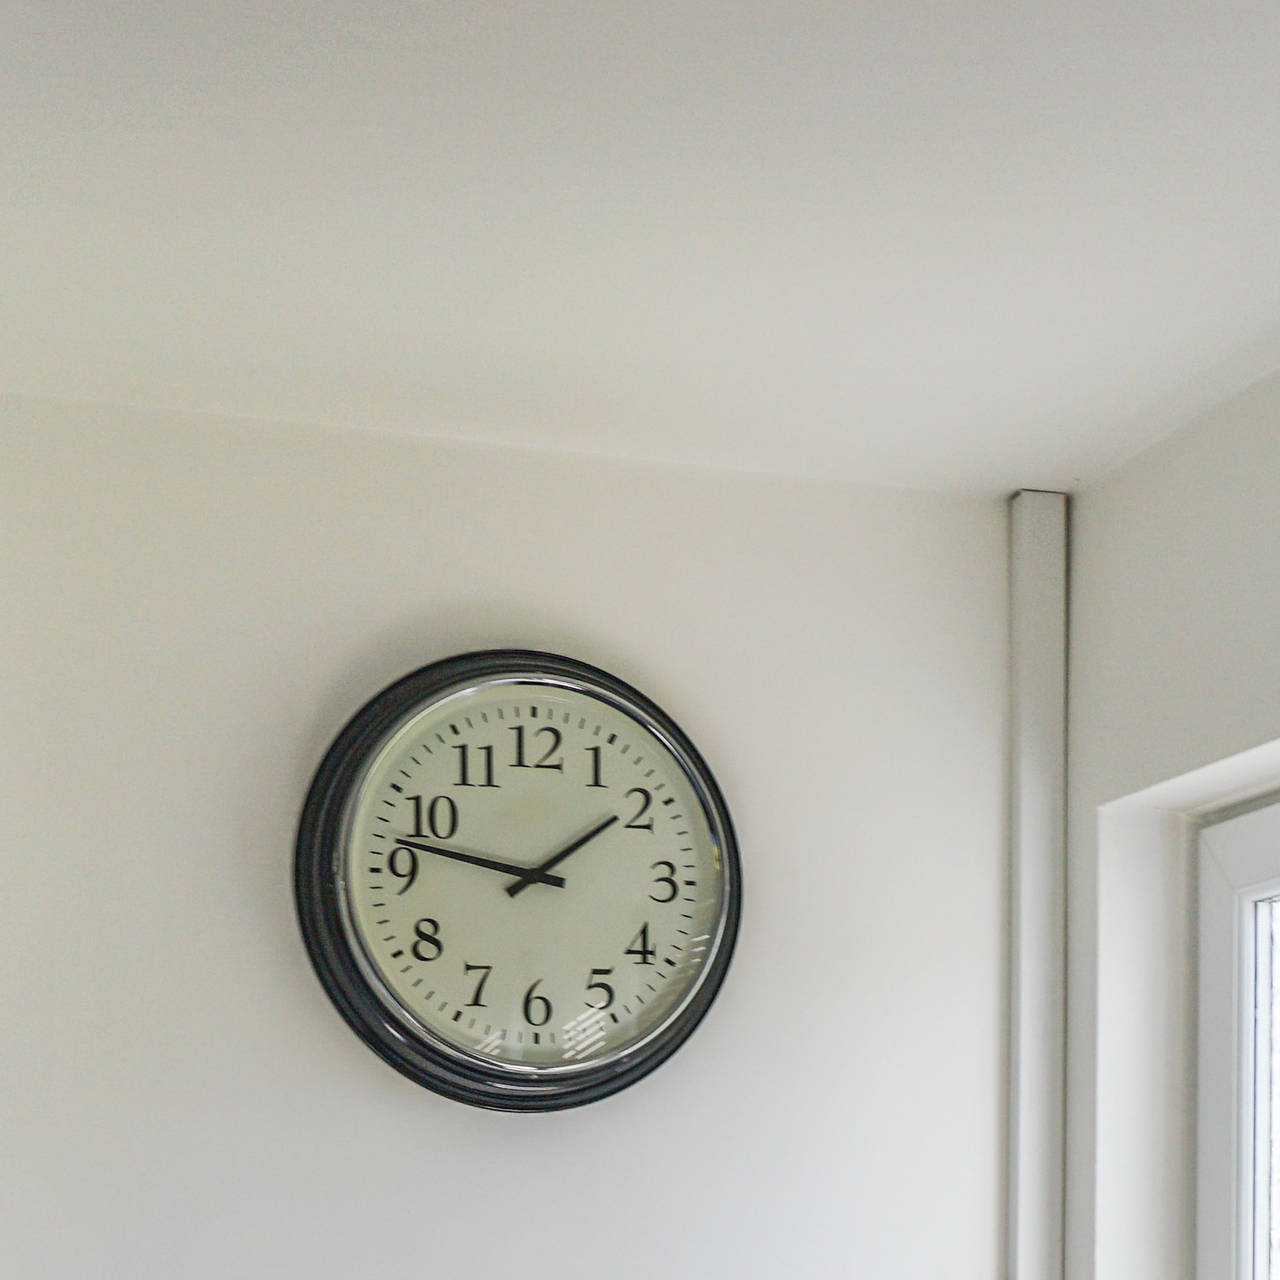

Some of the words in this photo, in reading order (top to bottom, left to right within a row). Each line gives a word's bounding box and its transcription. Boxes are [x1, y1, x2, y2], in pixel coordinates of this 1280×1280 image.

[452, 743, 501, 788] 11
[508, 725, 564, 771] 12
[584, 746, 610, 788] 1
[405, 794, 459, 840] 10
[623, 787, 655, 831] 2
[387, 846, 419, 896] 9
[648, 860, 678, 903] 3
[411, 918, 444, 962] 8
[624, 921, 657, 965] 4
[463, 962, 494, 1008] 7
[523, 978, 553, 1026] 6
[584, 968, 616, 1011] 5
